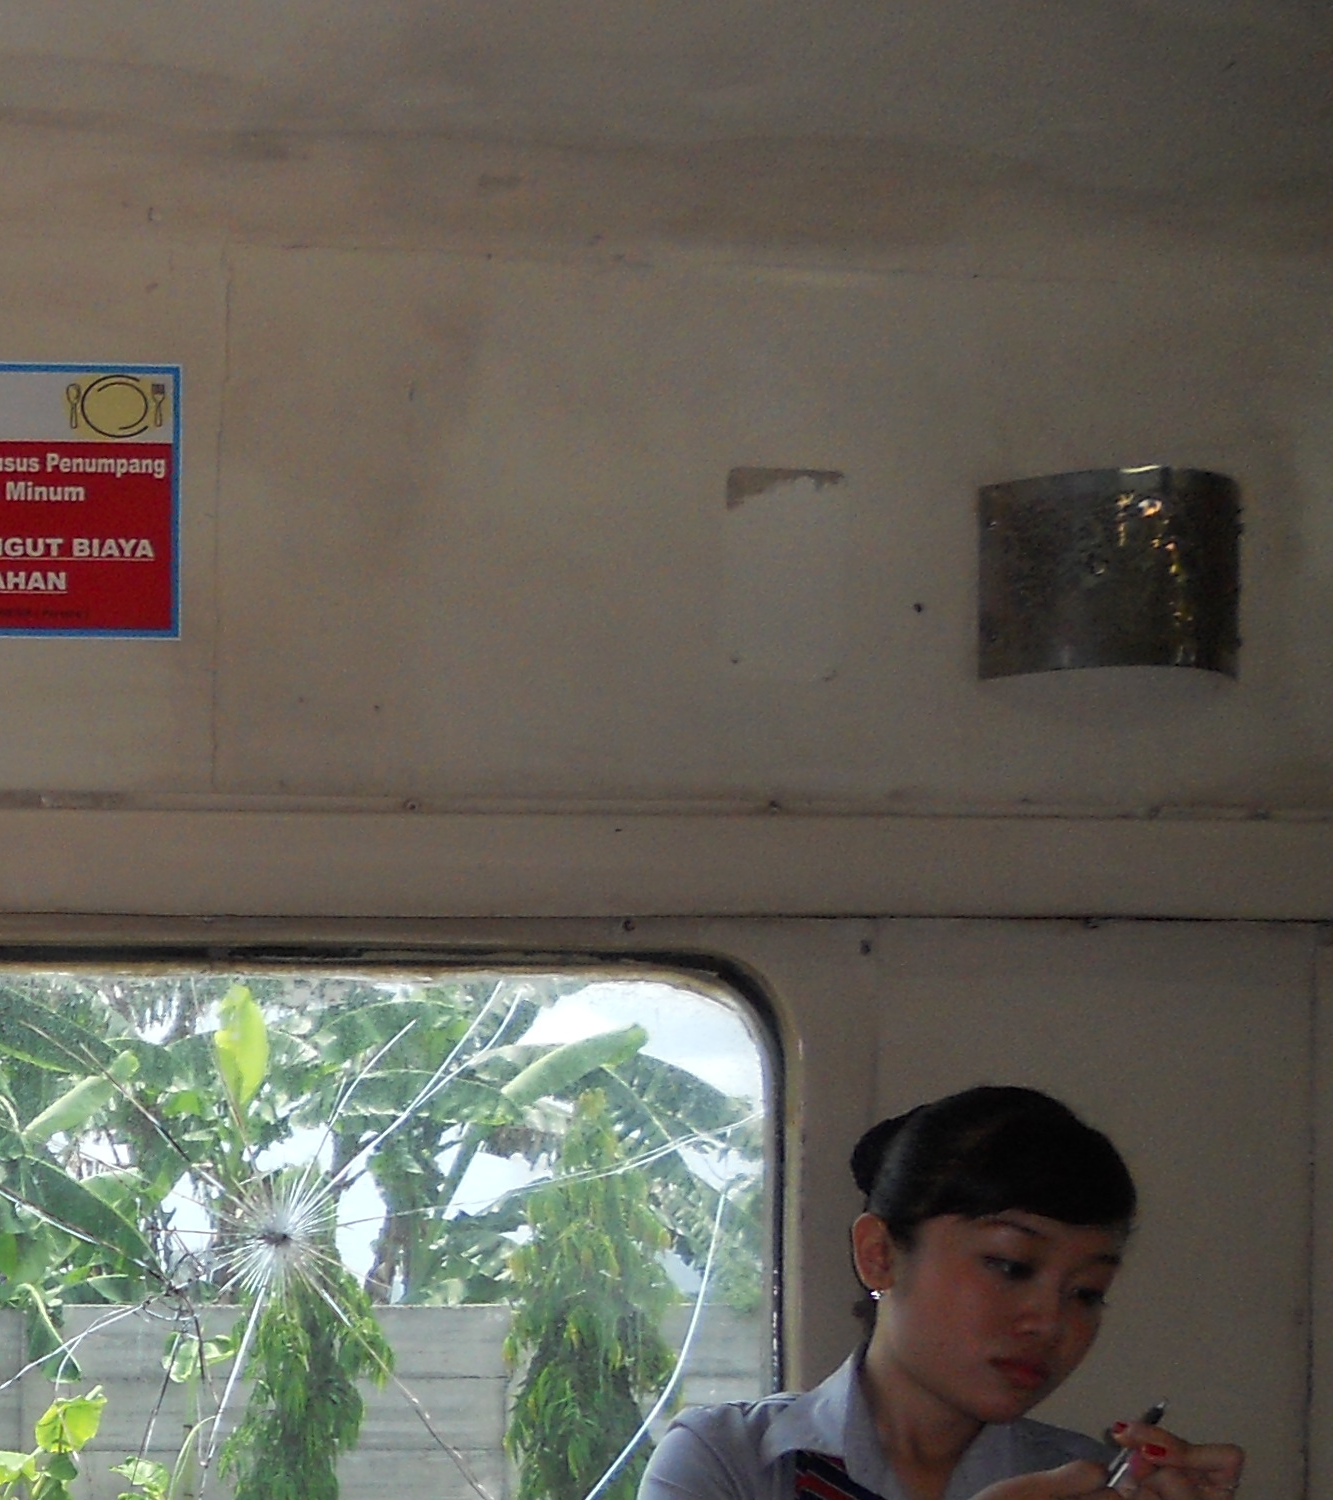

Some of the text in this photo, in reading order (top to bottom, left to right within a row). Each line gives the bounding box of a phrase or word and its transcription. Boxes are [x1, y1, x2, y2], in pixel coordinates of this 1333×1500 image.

[46, 452, 166, 479] Penumpang
[6, 482, 86, 502] Minum
[72, 539, 155, 558] BIAYA
